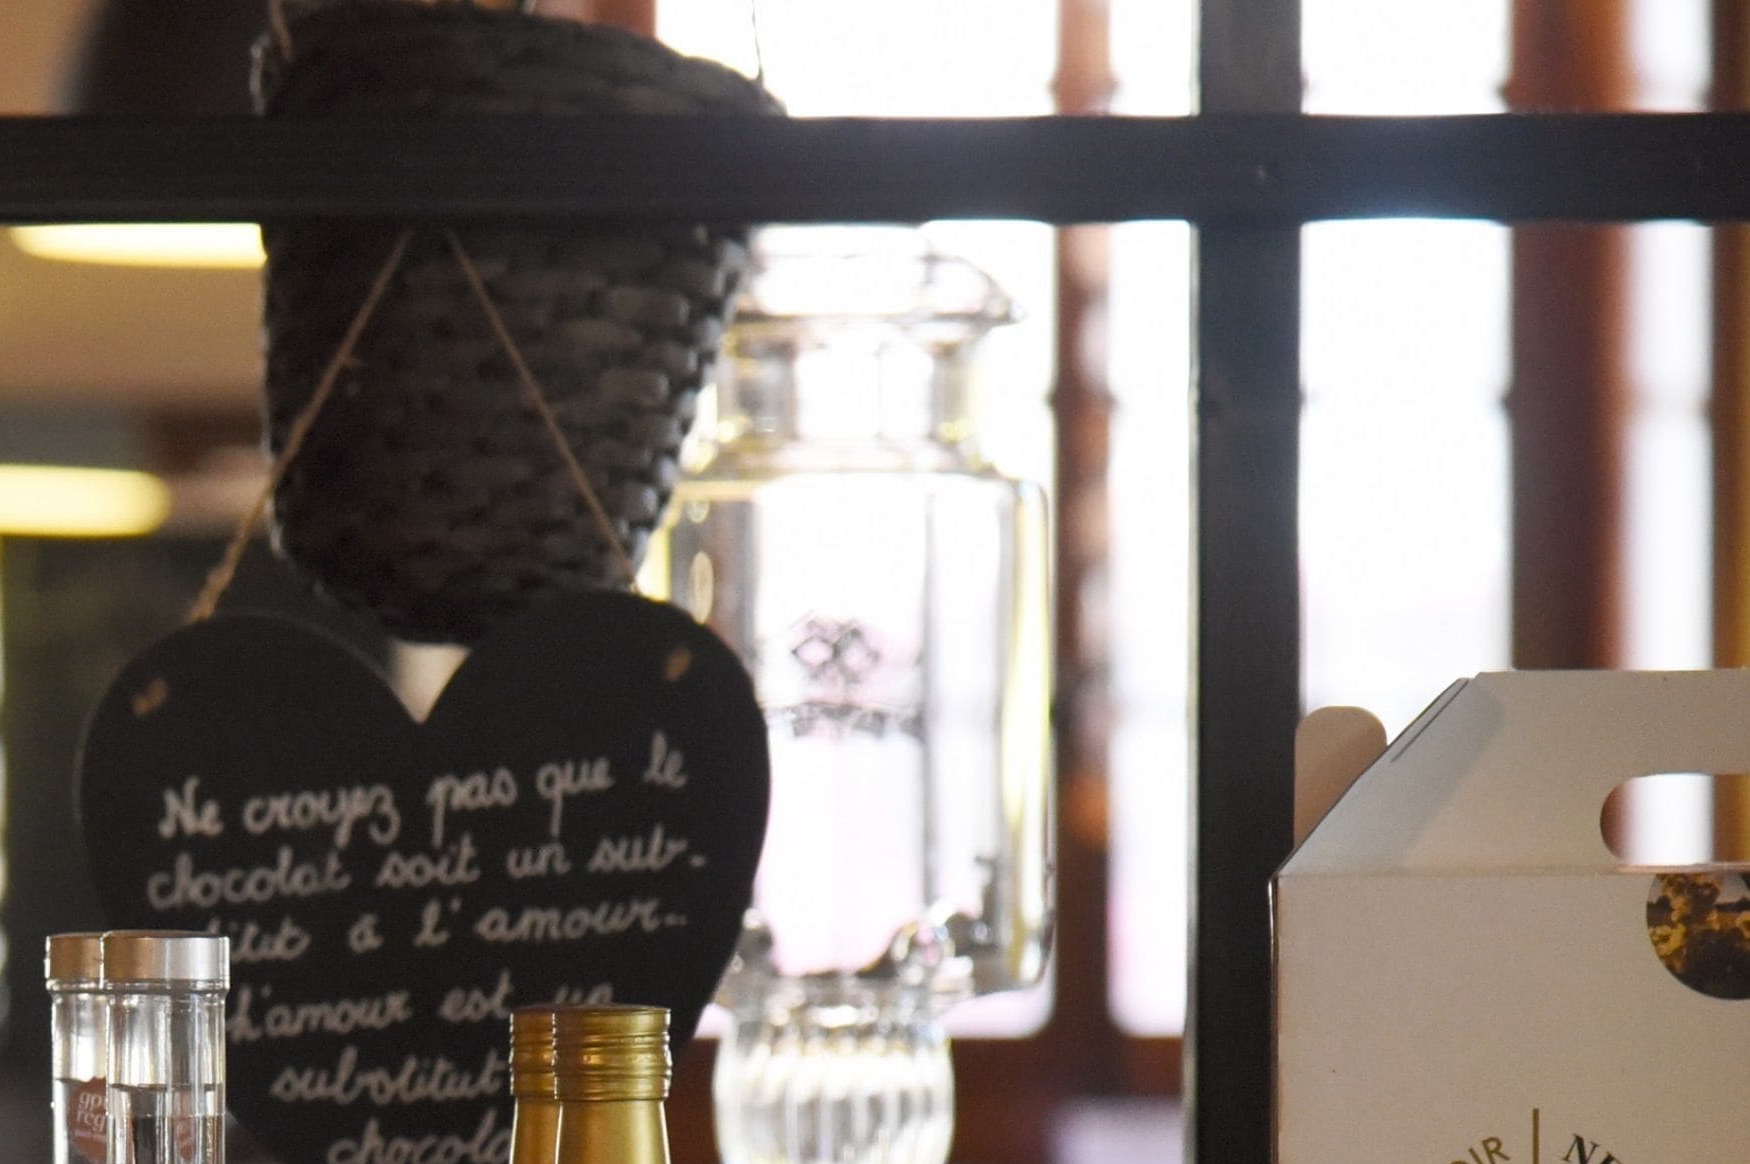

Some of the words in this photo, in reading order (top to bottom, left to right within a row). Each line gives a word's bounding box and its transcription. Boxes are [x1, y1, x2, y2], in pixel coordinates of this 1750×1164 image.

[158, 773, 225, 839] Ne
[426, 766, 518, 848] pas
[535, 756, 616, 840] que
[641, 730, 689, 789] le
[147, 845, 352, 911] chocolat
[375, 832, 482, 888] soit
[506, 841, 572, 879] un
[440, 969, 512, 1023] est
